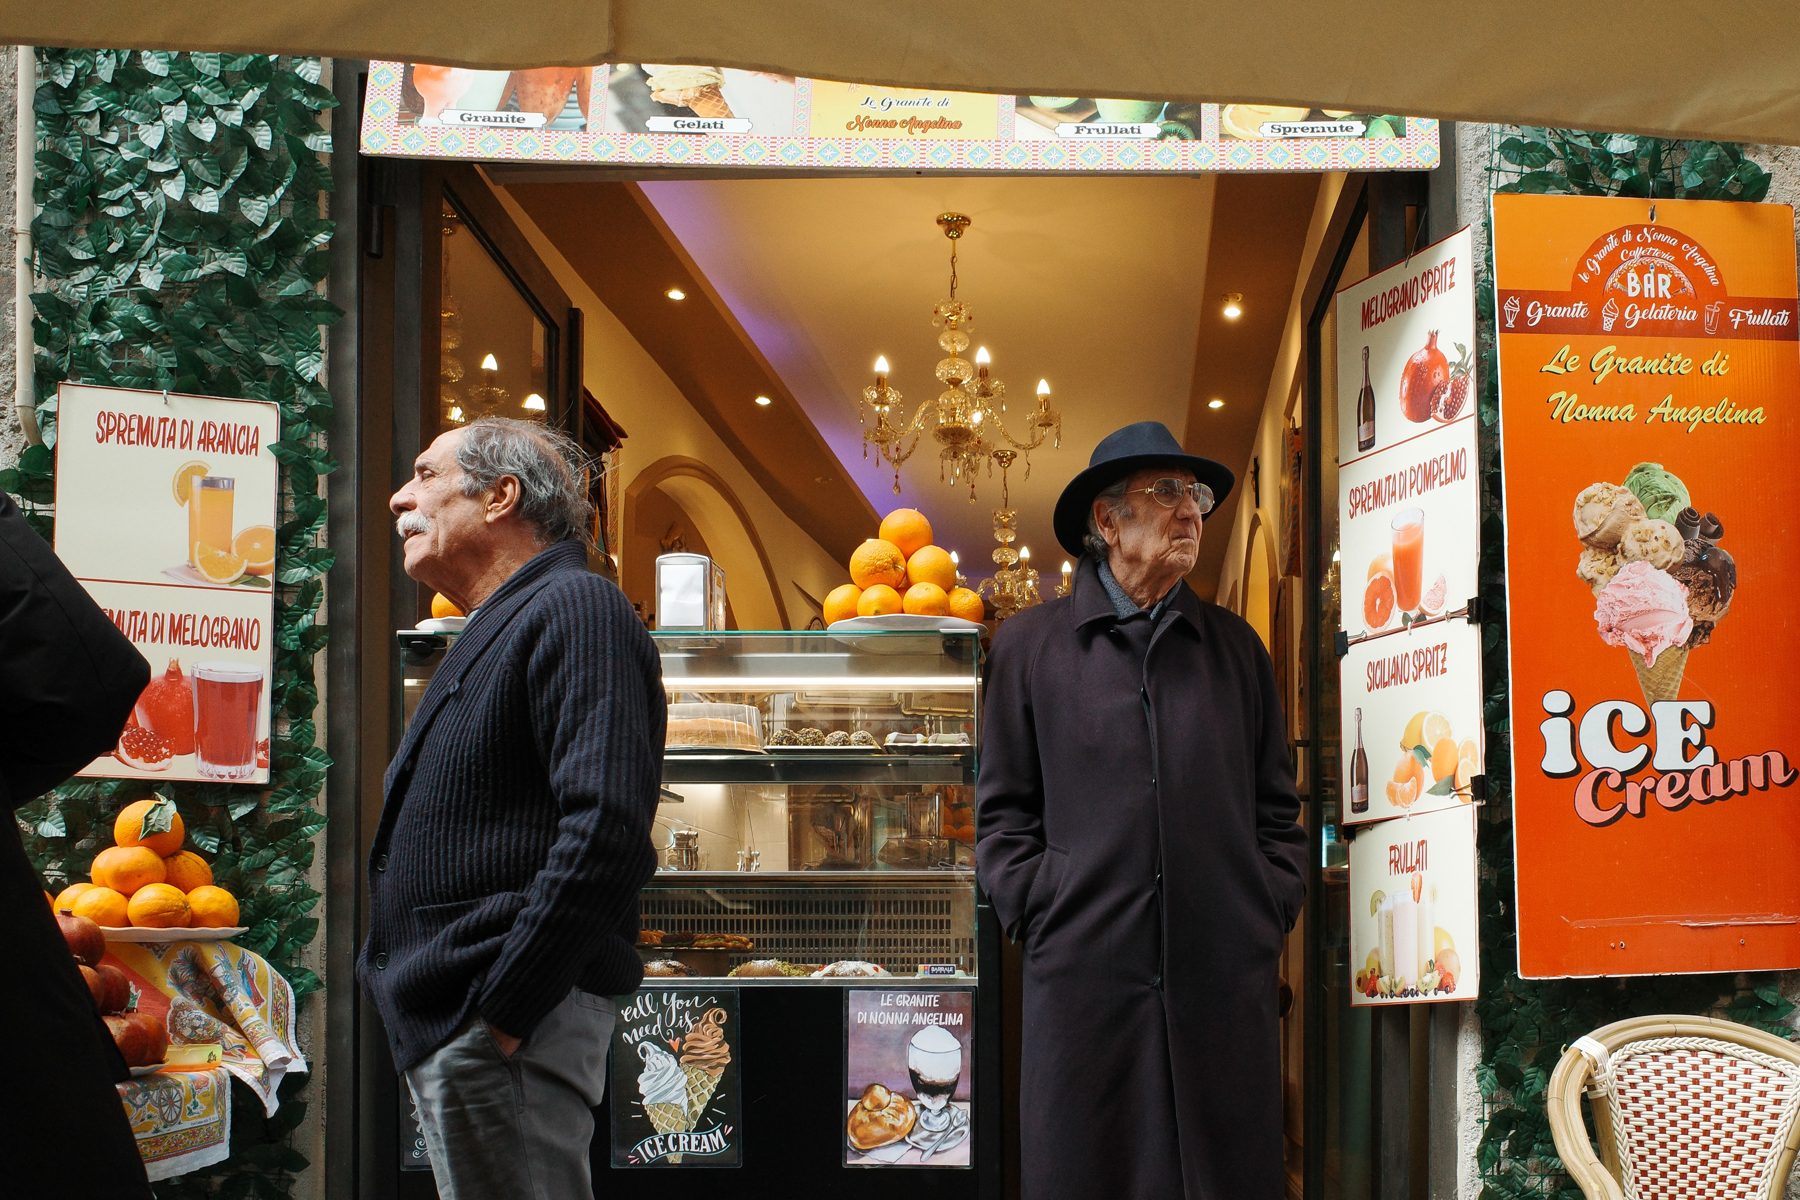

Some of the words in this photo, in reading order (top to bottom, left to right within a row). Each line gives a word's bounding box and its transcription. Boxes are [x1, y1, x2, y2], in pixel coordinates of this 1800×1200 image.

[459, 112, 526, 124] Granite
[880, 97, 933, 111] Granite
[937, 97, 951, 107] di
[673, 119, 725, 130] Gelati
[846, 115, 898, 132] Nonna
[899, 116, 963, 135] Angelina
[1074, 125, 1142, 135] Frullati
[1270, 124, 1354, 136] Spremute
[1586, 233, 1620, 275] Granite
[1622, 228, 1632, 244] di
[1636, 227, 1678, 246] Nonna
[1682, 243, 1720, 287] Angelina
[1361, 275, 1419, 331] MELOGRANO
[1420, 257, 1456, 304] SPRITZ
[1627, 272, 1672, 299] BAR
[1526, 301, 1590, 327] Granite
[1624, 303, 1698, 329] Gelateria
[1728, 308, 1790, 330] Frullati
[1540, 344, 1581, 376] Le
[1590, 345, 1693, 384] Granite
[1700, 351, 1730, 376] di
[1547, 390, 1638, 424] Nonna
[1645, 394, 1767, 433] Angelina
[95, 410, 177, 449] SPREMUTA
[180, 420, 194, 451] DI
[197, 420, 260, 457] ARANCIA
[1349, 472, 1397, 520] SPREMUTA
[1398, 469, 1408, 502] DI
[1409, 447, 1467, 497] POMPELMO
[151, 613, 165, 644] DI
[168, 613, 261, 651] MELOGRANO
[1366, 652, 1410, 693] SICILIANO
[1411, 642, 1448, 683] SPRITZ
[1574, 750, 1799, 827] Cream
[1389, 839, 1428, 876] FRULLATI
[880, 993, 893, 1006] LE
[896, 994, 940, 1007] GRANITE
[622, 1013, 669, 1045] need
[675, 1010, 699, 1034] is
[857, 1011, 867, 1024] DI
[869, 1011, 909, 1025] NONNA
[911, 1012, 964, 1025] ANGELINA
[636, 1135, 668, 1164] ICE
[667, 1128, 727, 1153] CREAM
